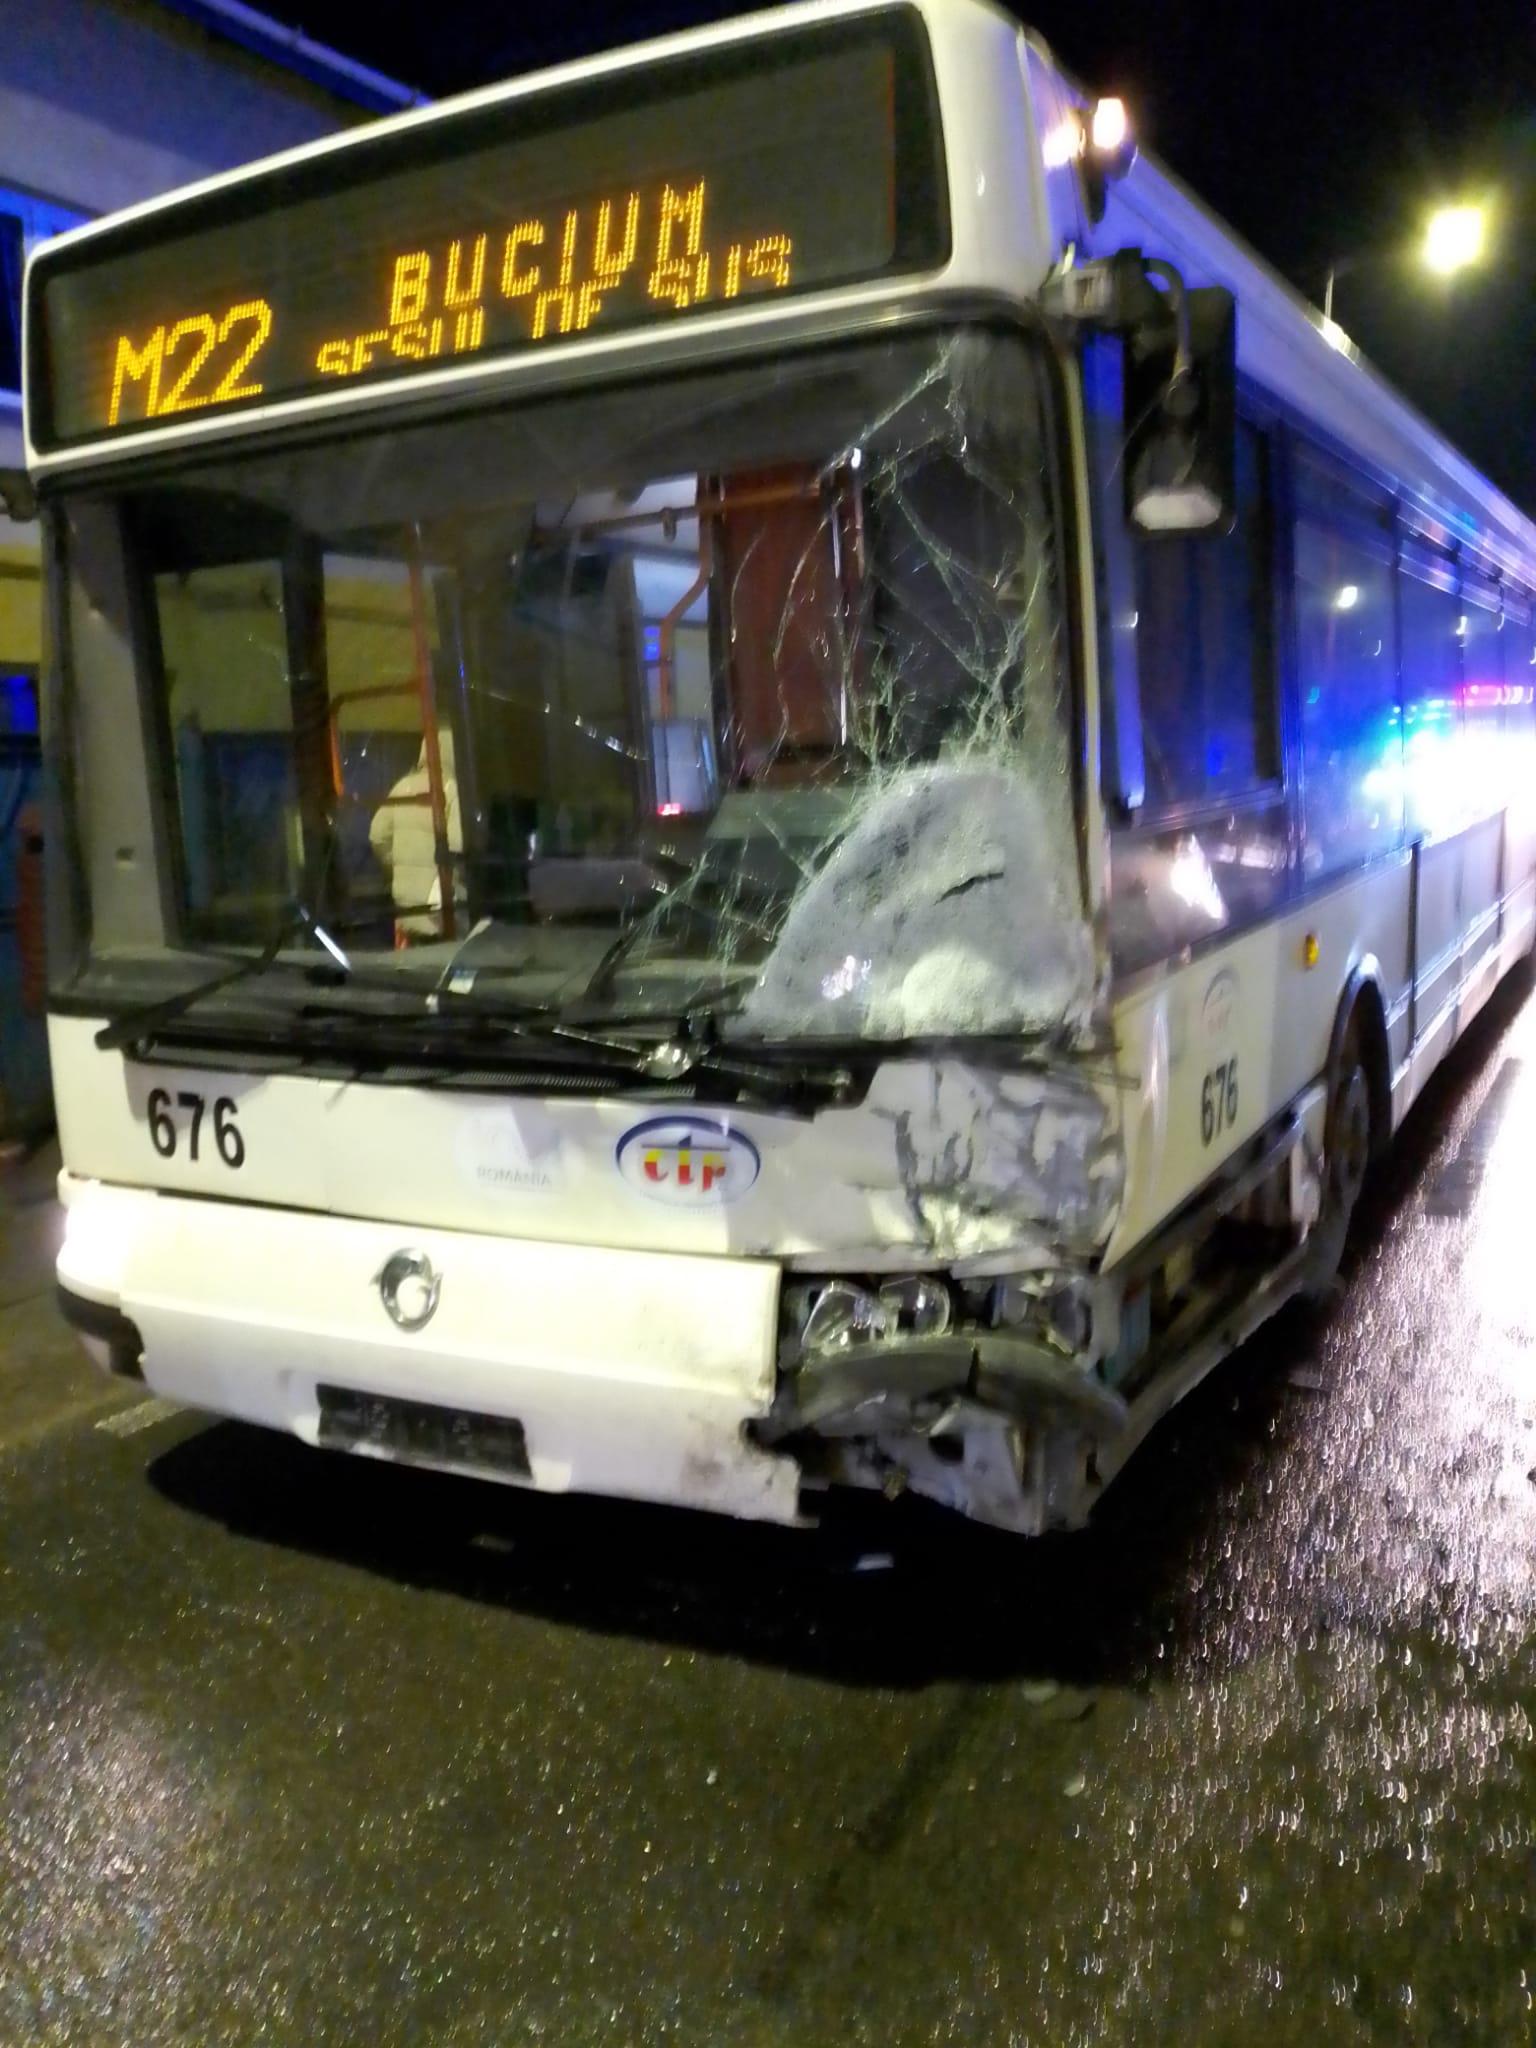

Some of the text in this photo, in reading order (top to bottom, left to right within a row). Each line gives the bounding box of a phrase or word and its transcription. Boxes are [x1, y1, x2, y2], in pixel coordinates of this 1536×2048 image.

[389, 175, 705, 326] BUCIUM
[107, 298, 273, 426] M22
[147, 1087, 245, 1170] 676
[1201, 1053, 1239, 1148] 676
